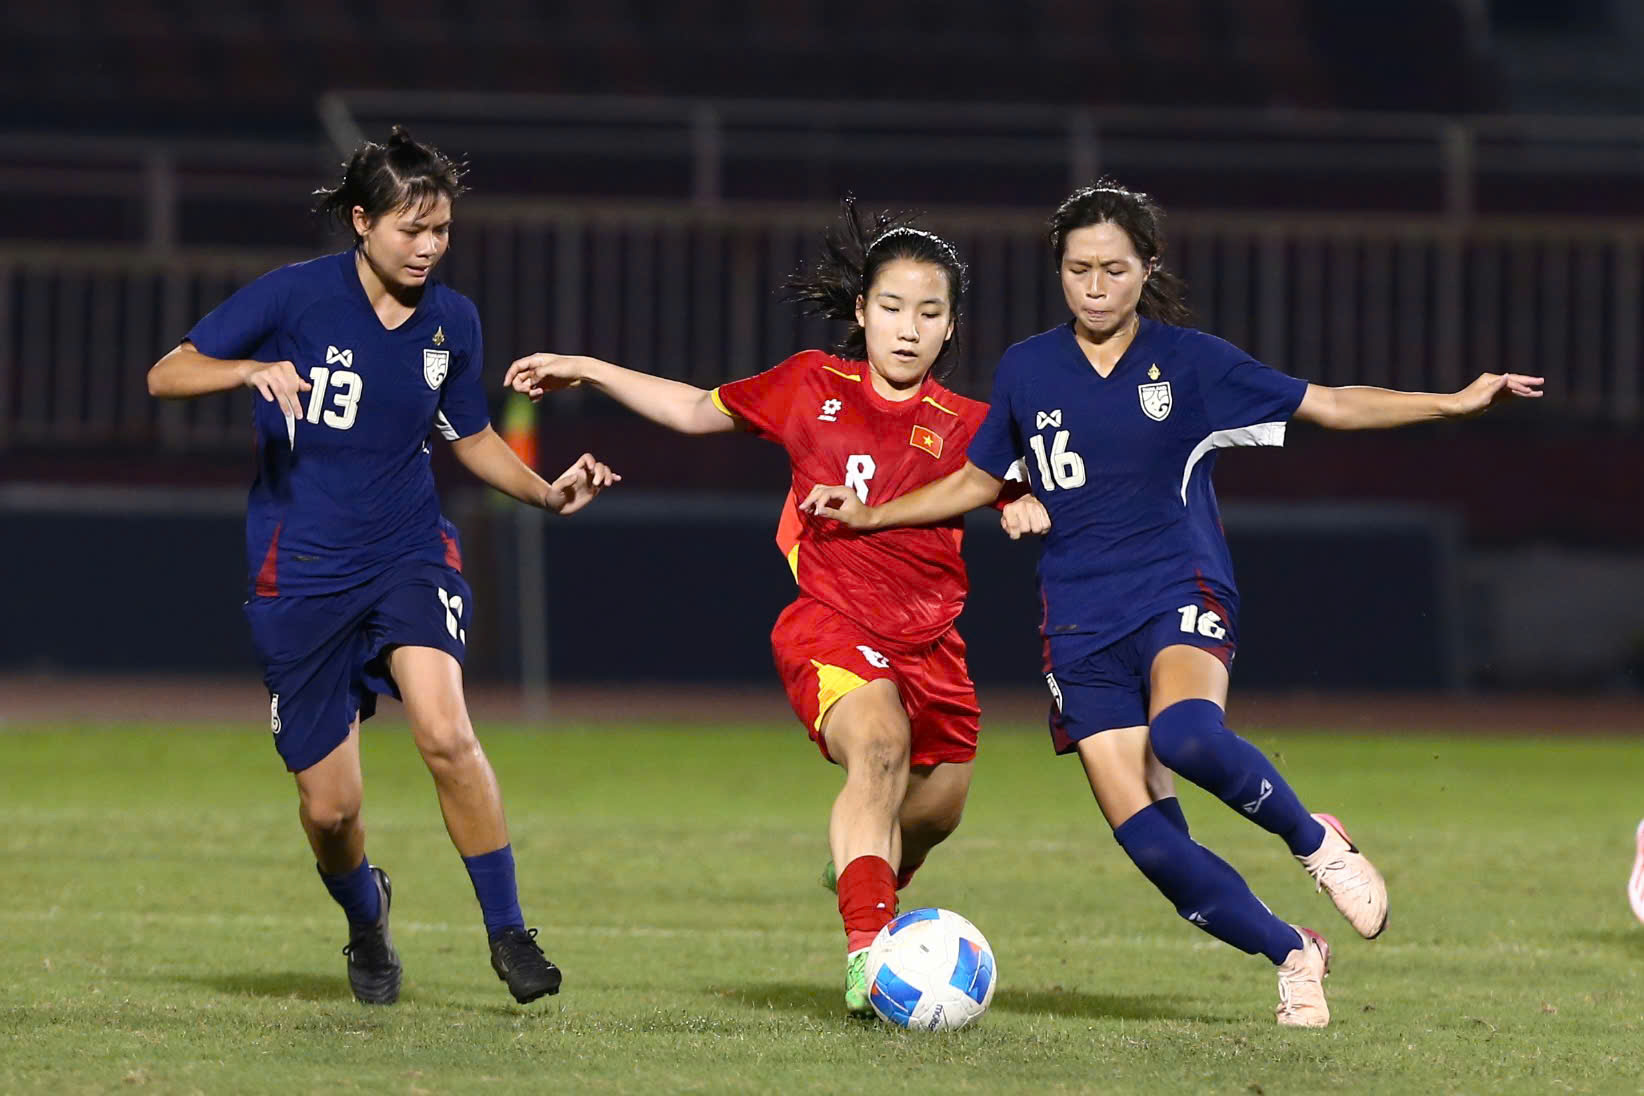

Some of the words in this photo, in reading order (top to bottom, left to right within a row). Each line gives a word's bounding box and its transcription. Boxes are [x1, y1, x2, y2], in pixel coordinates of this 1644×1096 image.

[306, 366, 363, 430] 13
[1029, 429, 1086, 491] 16
[1177, 604, 1226, 640] 16
